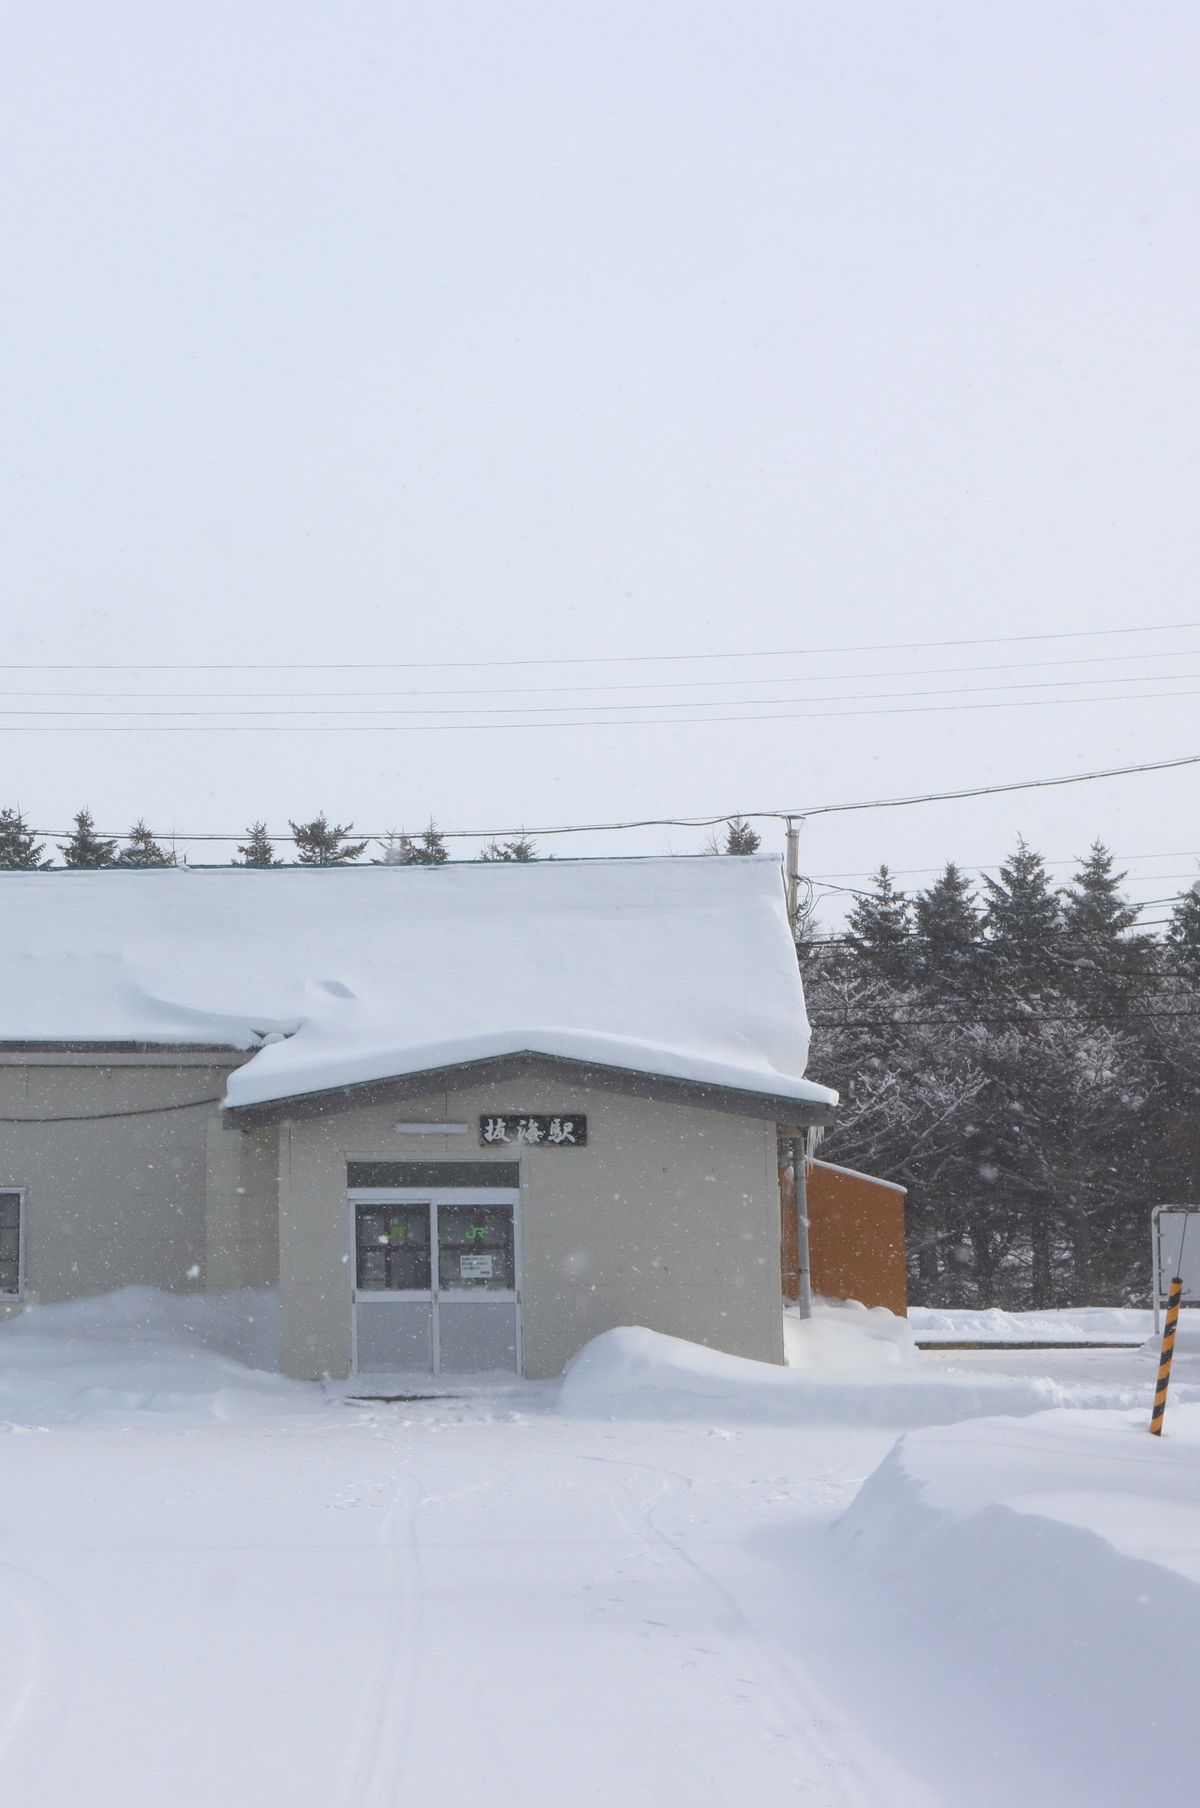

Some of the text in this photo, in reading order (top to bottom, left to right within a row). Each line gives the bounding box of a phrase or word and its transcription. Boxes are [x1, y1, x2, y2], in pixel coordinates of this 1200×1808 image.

[484, 1118, 576, 1144] 抜海駅
[466, 1227, 487, 1240] JR
